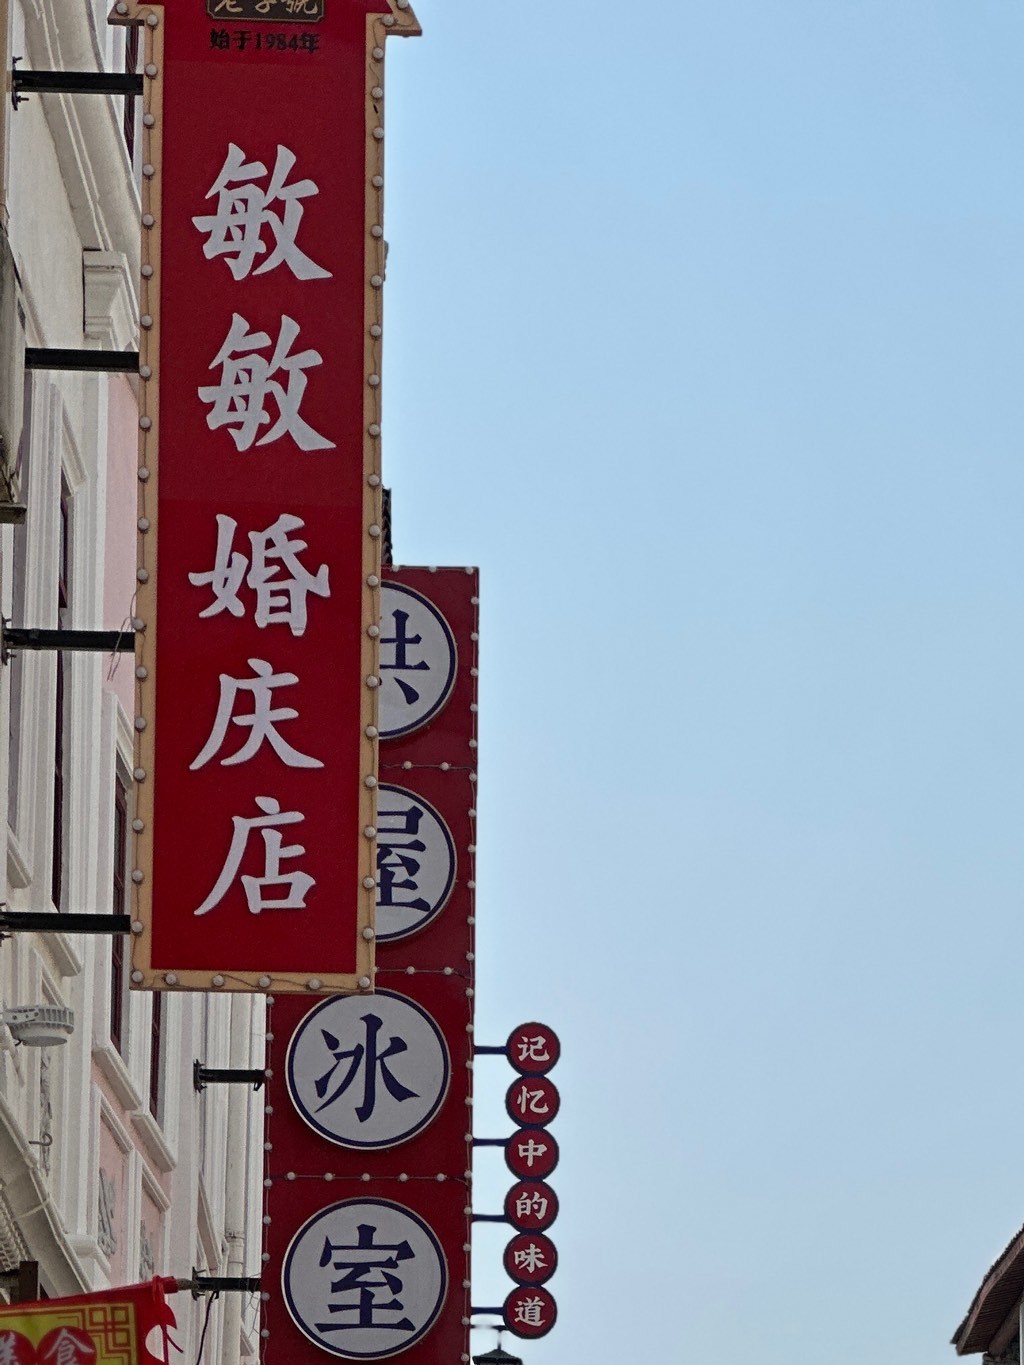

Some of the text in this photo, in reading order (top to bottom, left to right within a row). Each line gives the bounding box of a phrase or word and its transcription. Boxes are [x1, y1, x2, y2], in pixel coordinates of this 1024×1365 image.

[189, 142, 336, 916] 敏敏婚庆店
[516, 1035, 551, 1326] 记忆中的味道
